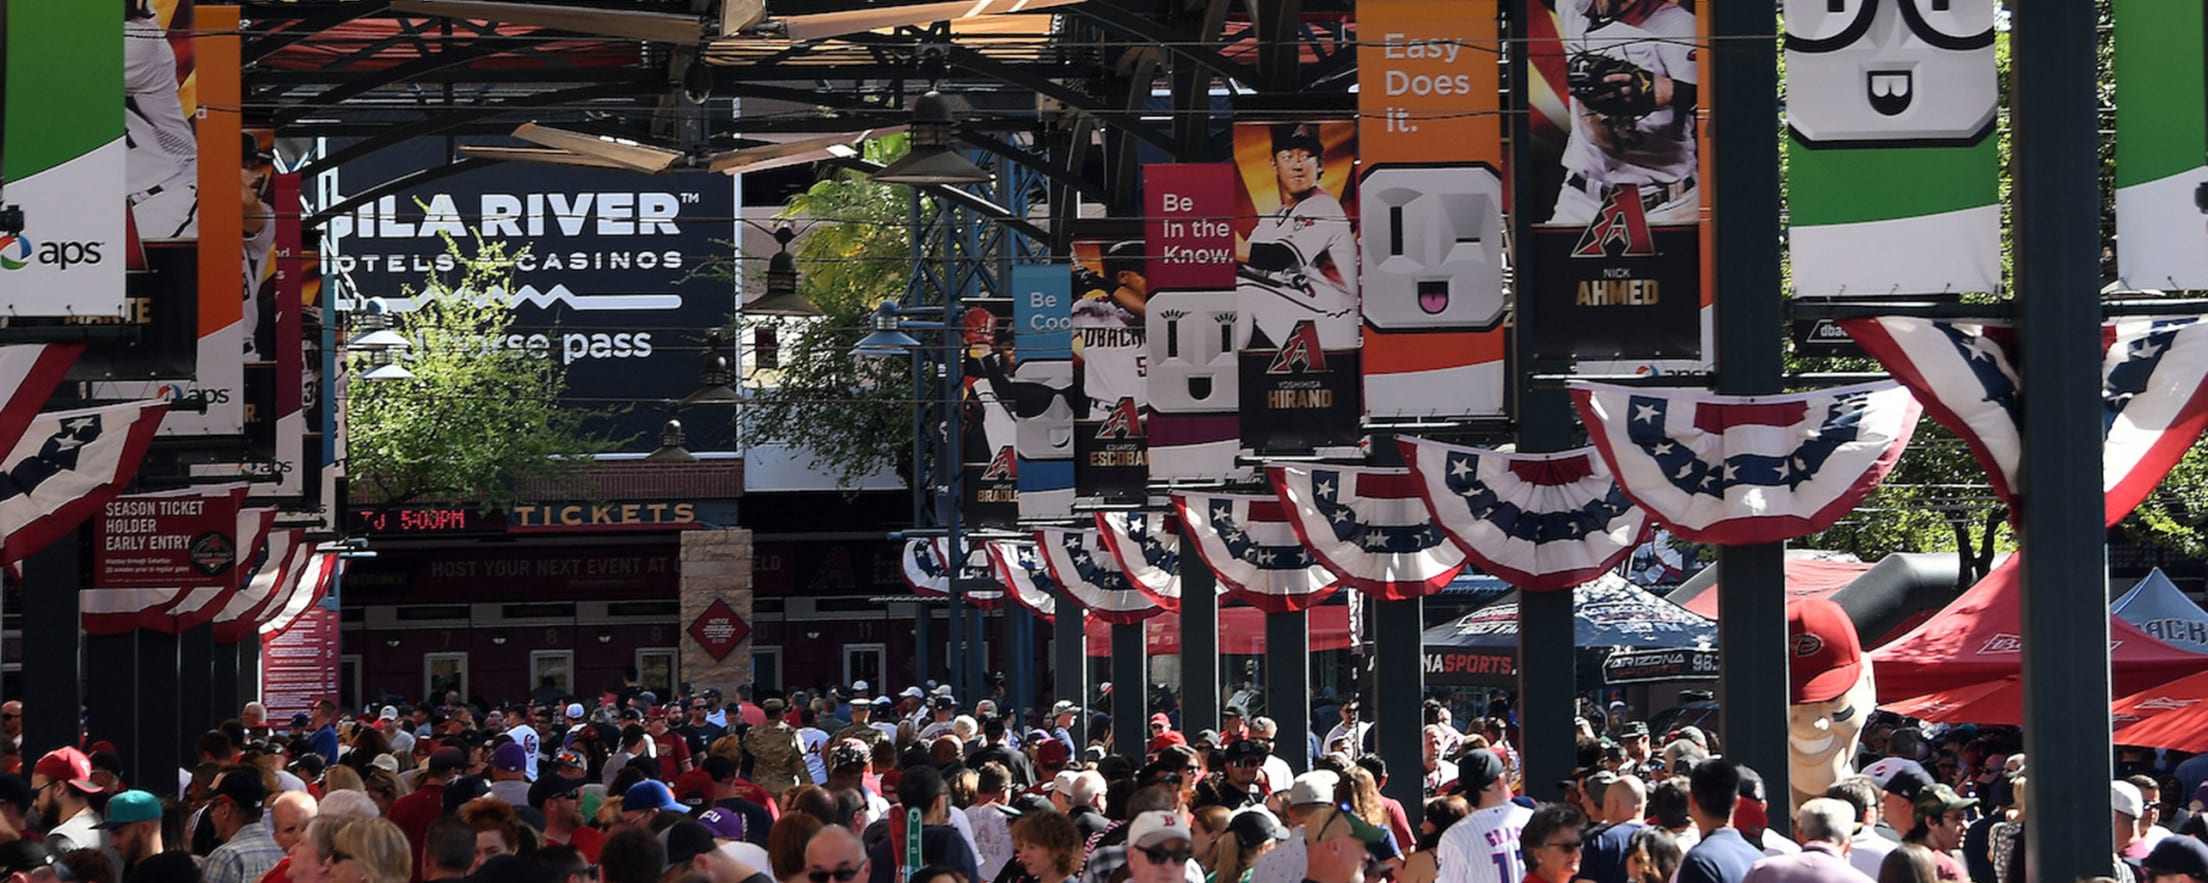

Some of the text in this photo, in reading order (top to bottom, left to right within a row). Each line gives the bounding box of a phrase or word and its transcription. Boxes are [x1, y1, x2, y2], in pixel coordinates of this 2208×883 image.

[1385, 33, 1462, 63] Easy
[1386, 70, 1470, 96] Does
[1387, 107, 1418, 133] it.
[1163, 193, 1194, 212] Be
[1192, 219, 1230, 238] the
[39, 241, 102, 270] aps
[515, 250, 683, 271] CASINOS
[1163, 245, 1234, 264] Know.
[1603, 268, 1631, 278] NICK
[1030, 292, 1057, 308] Be
[1576, 280, 1660, 306] AHMED
[562, 331, 652, 365] pass
[1084, 328, 1147, 349] DBACK
[1267, 389, 1333, 409] HIRANO
[105, 500, 205, 517] SEASON TICKET
[514, 503, 697, 527] TICKETS
[105, 518, 157, 534] HOLDER
[105, 534, 192, 551] EARLY ENTRY
[431, 560, 478, 578] HOST
[482, 559, 531, 577] YOUR
[536, 558, 581, 577] NEXT
[587, 557, 641, 576] EVENT
[647, 556, 669, 575] AT
[1609, 653, 1685, 669] ARIZONA
